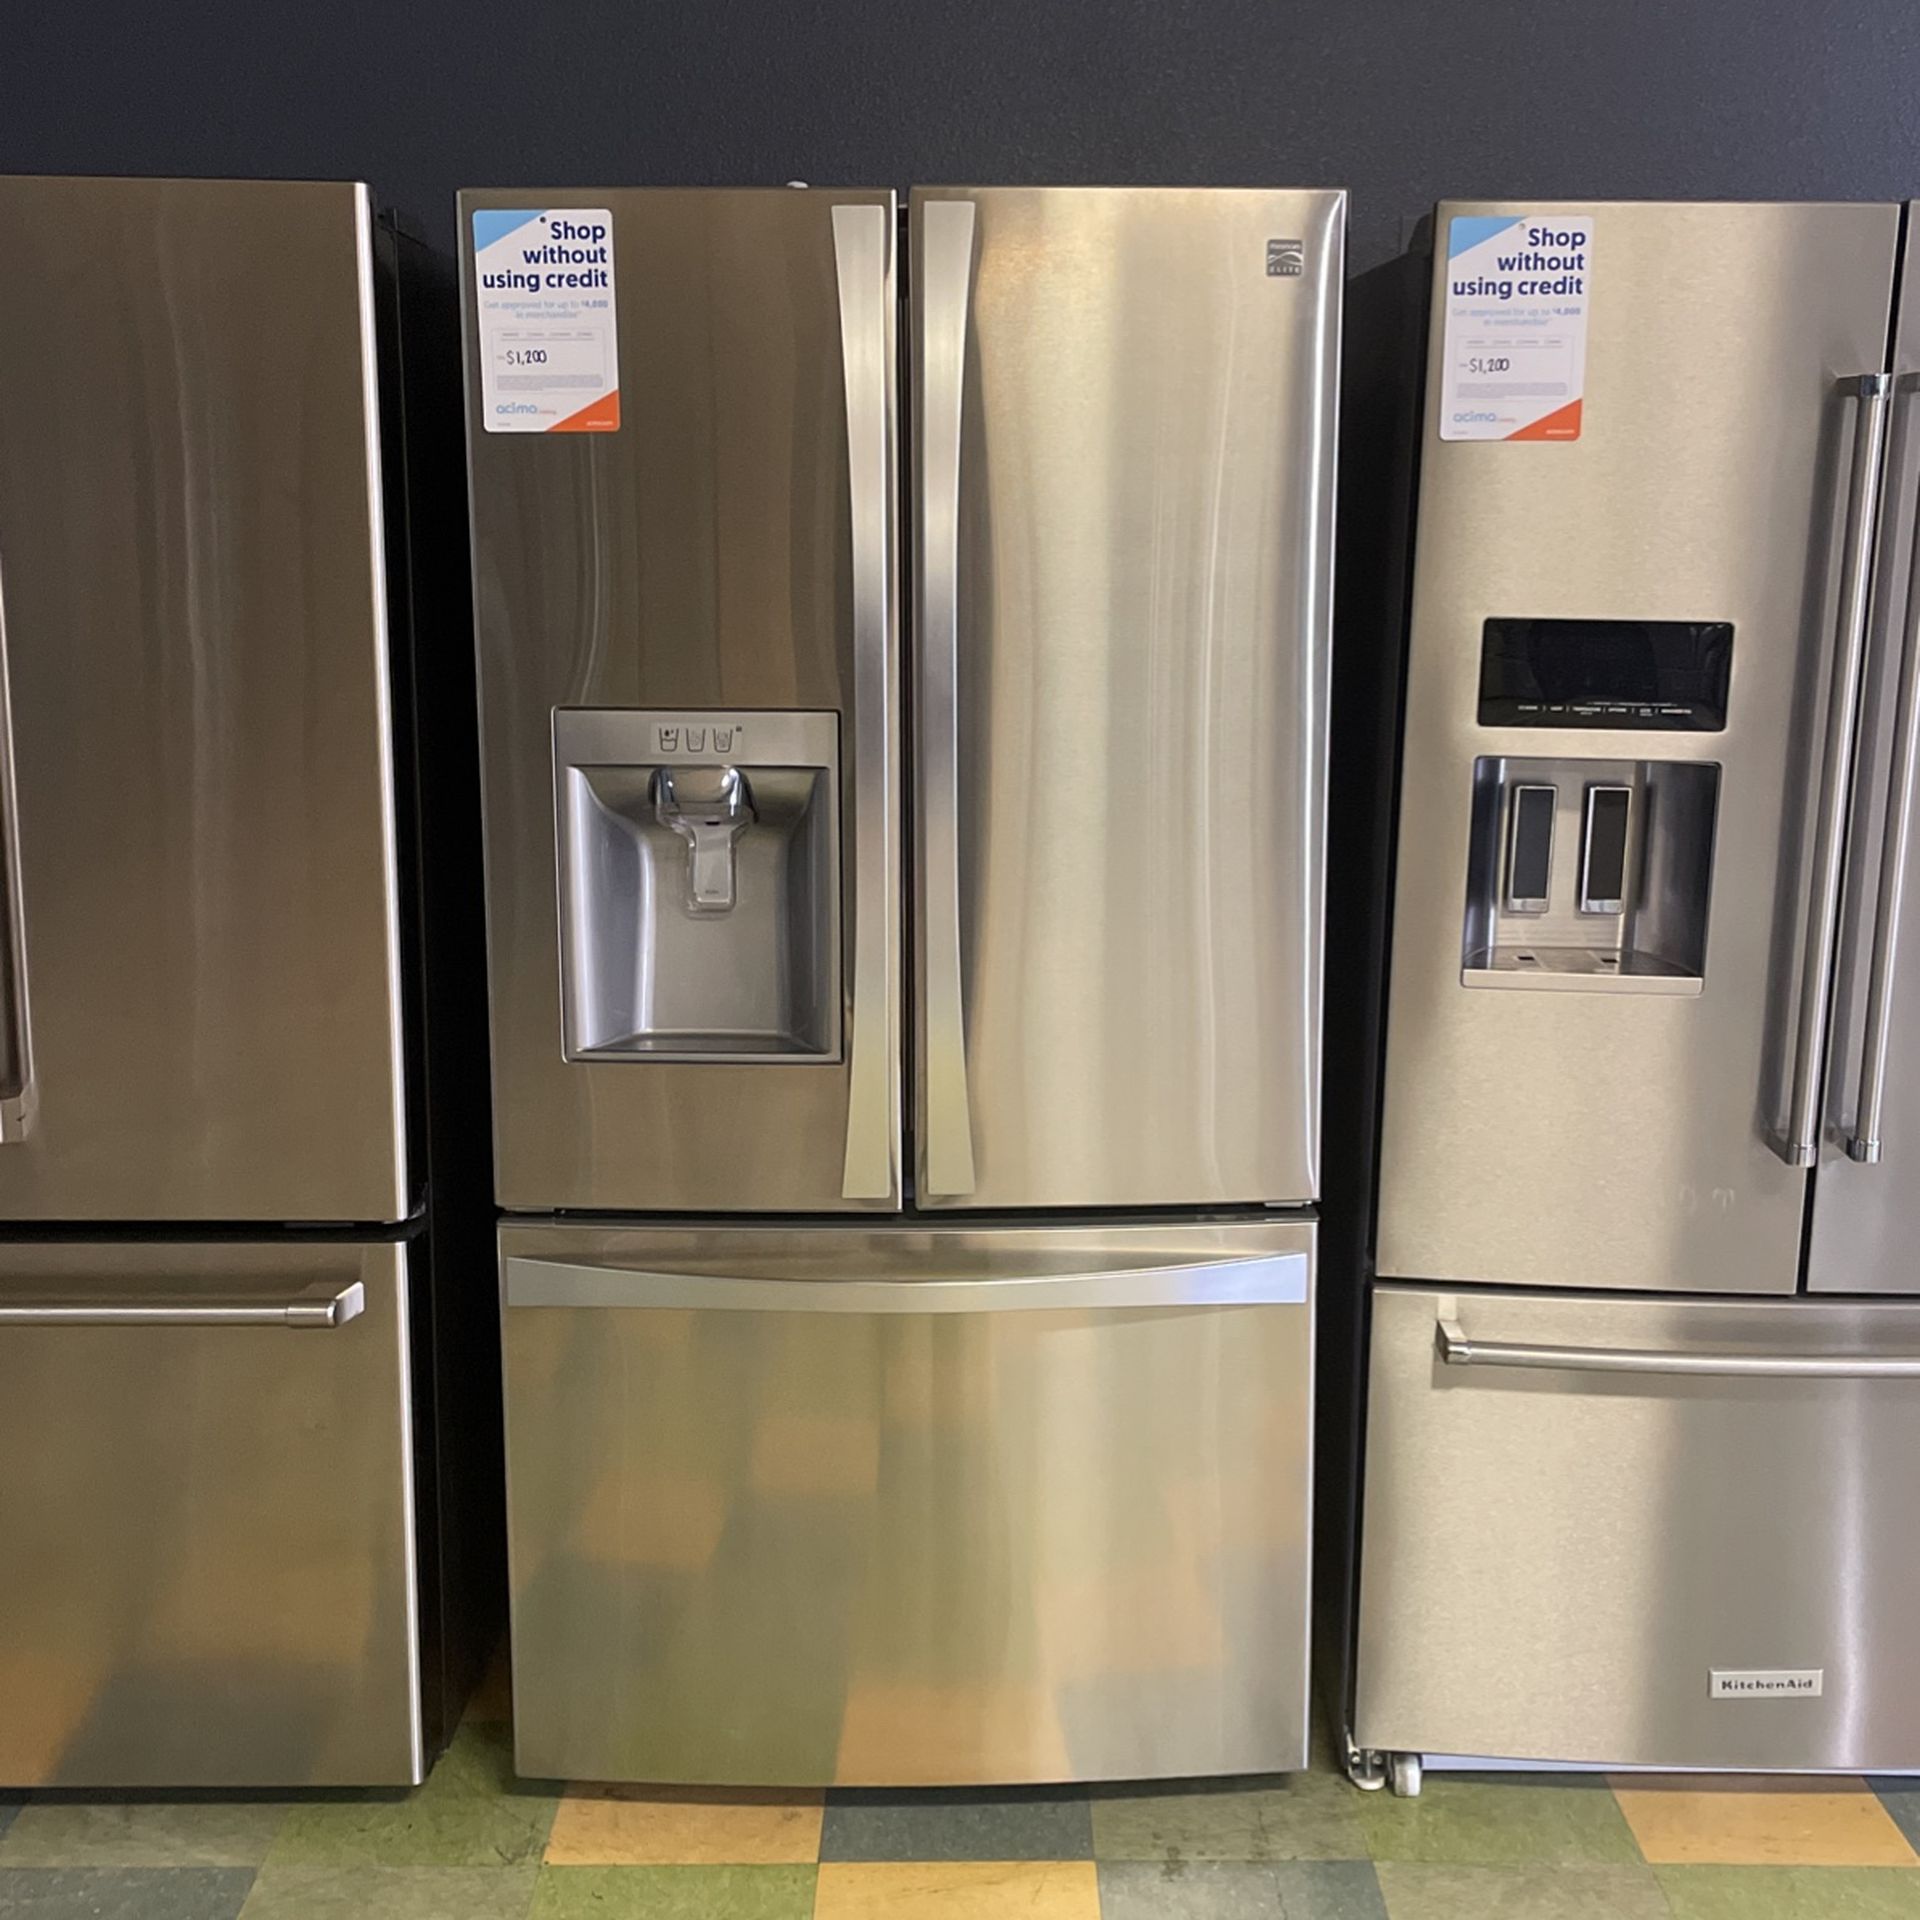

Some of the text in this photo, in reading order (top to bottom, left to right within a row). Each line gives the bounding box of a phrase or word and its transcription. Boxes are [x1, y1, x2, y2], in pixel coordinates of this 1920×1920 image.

[550, 220, 606, 244] Shop
[1528, 227, 1586, 251] Shop
[523, 245, 607, 264] without
[1497, 252, 1585, 271] without
[483, 269, 608, 293] using credit
[1453, 276, 1583, 300] using credit
[496, 402, 538, 415] acima
[1721, 1679, 1813, 1690] KitchenAid
